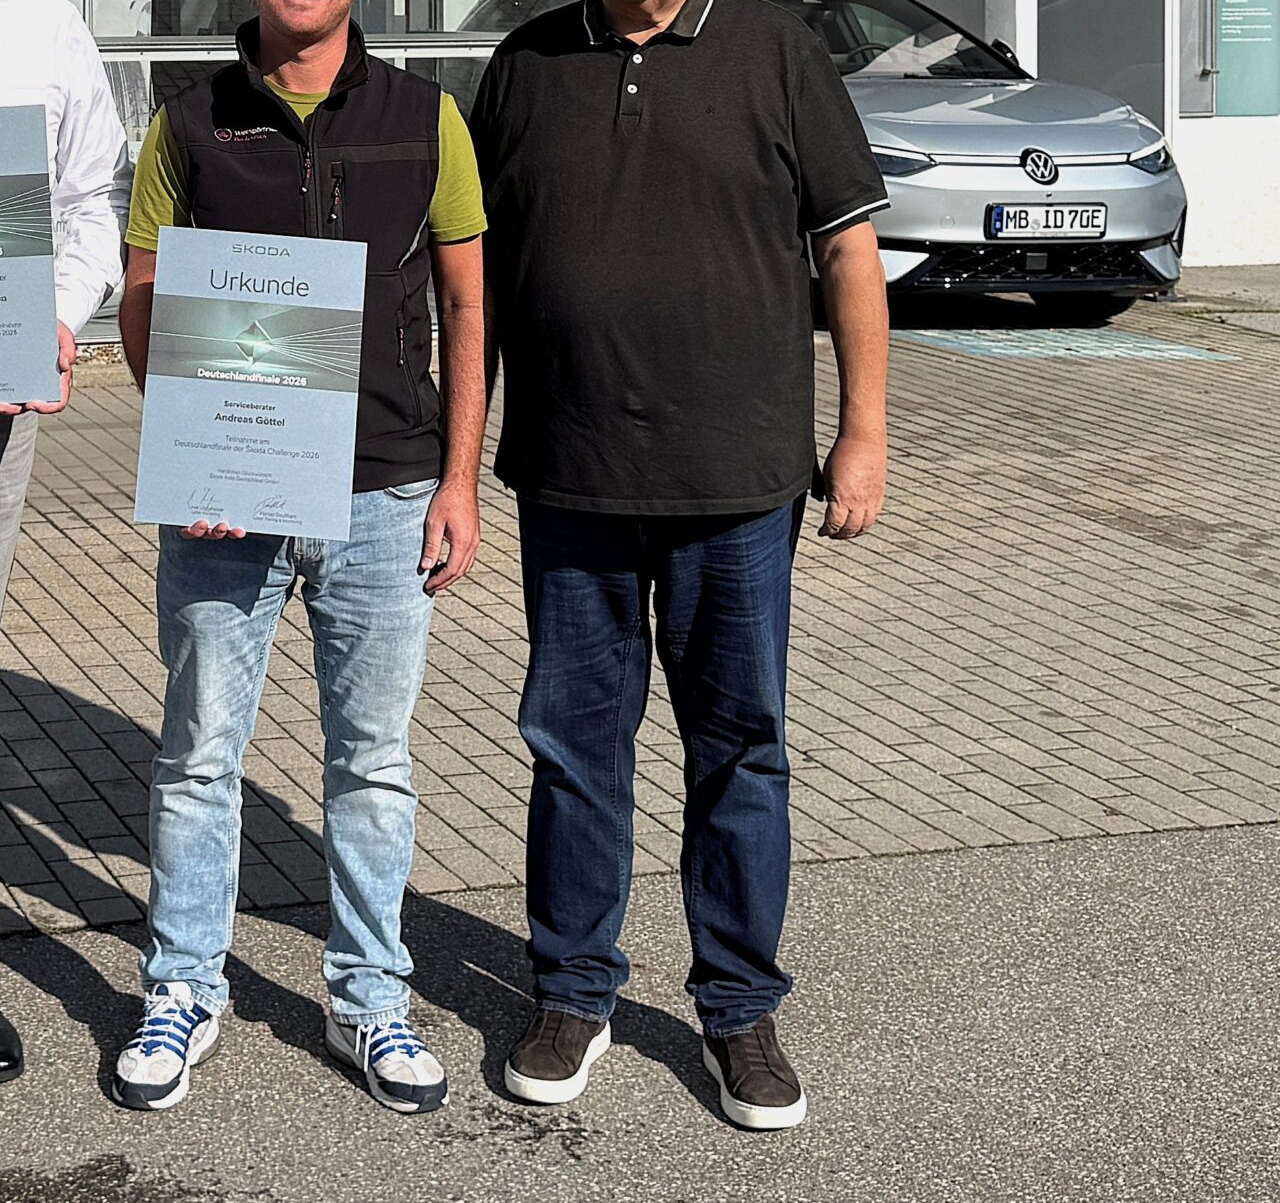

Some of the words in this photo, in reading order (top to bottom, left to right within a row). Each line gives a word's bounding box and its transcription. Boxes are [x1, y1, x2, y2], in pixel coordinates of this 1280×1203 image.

[1005, 209, 1029, 229] MB
[210, 268, 310, 297] Urkunde
[197, 368, 281, 385] Deutschlandfinale
[282, 375, 308, 387] 2026
[224, 400, 276, 412] Serviceberater
[214, 412, 254, 424] Andreas
[255, 416, 286, 427] Göttel
[174, 439, 233, 451] Deutschlandfinale
[233, 444, 244, 452] der
[267, 447, 300, 459] Challenge
[301, 450, 320, 459] 2026
[225, 434, 259, 445] Teilnahme
